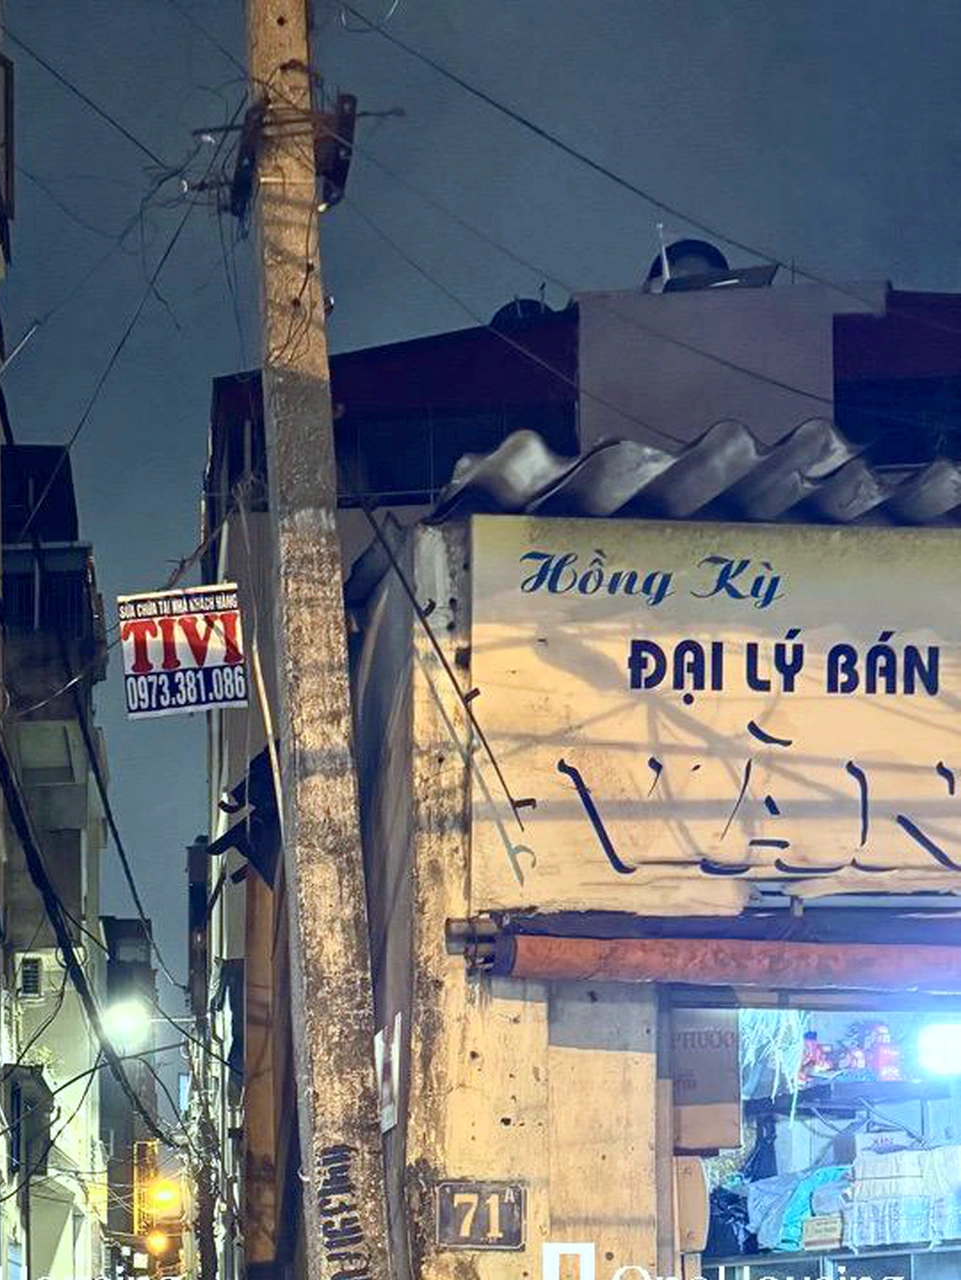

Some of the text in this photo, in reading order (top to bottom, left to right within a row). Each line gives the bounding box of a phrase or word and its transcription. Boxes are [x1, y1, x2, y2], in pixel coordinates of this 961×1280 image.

[519, 548, 786, 609] Hồng Kỳ
[121, 612, 244, 673] TIVI
[628, 629, 940, 705] ĐẠI LÝ BÁN
[127, 666, 246, 711] 0973.381.086
